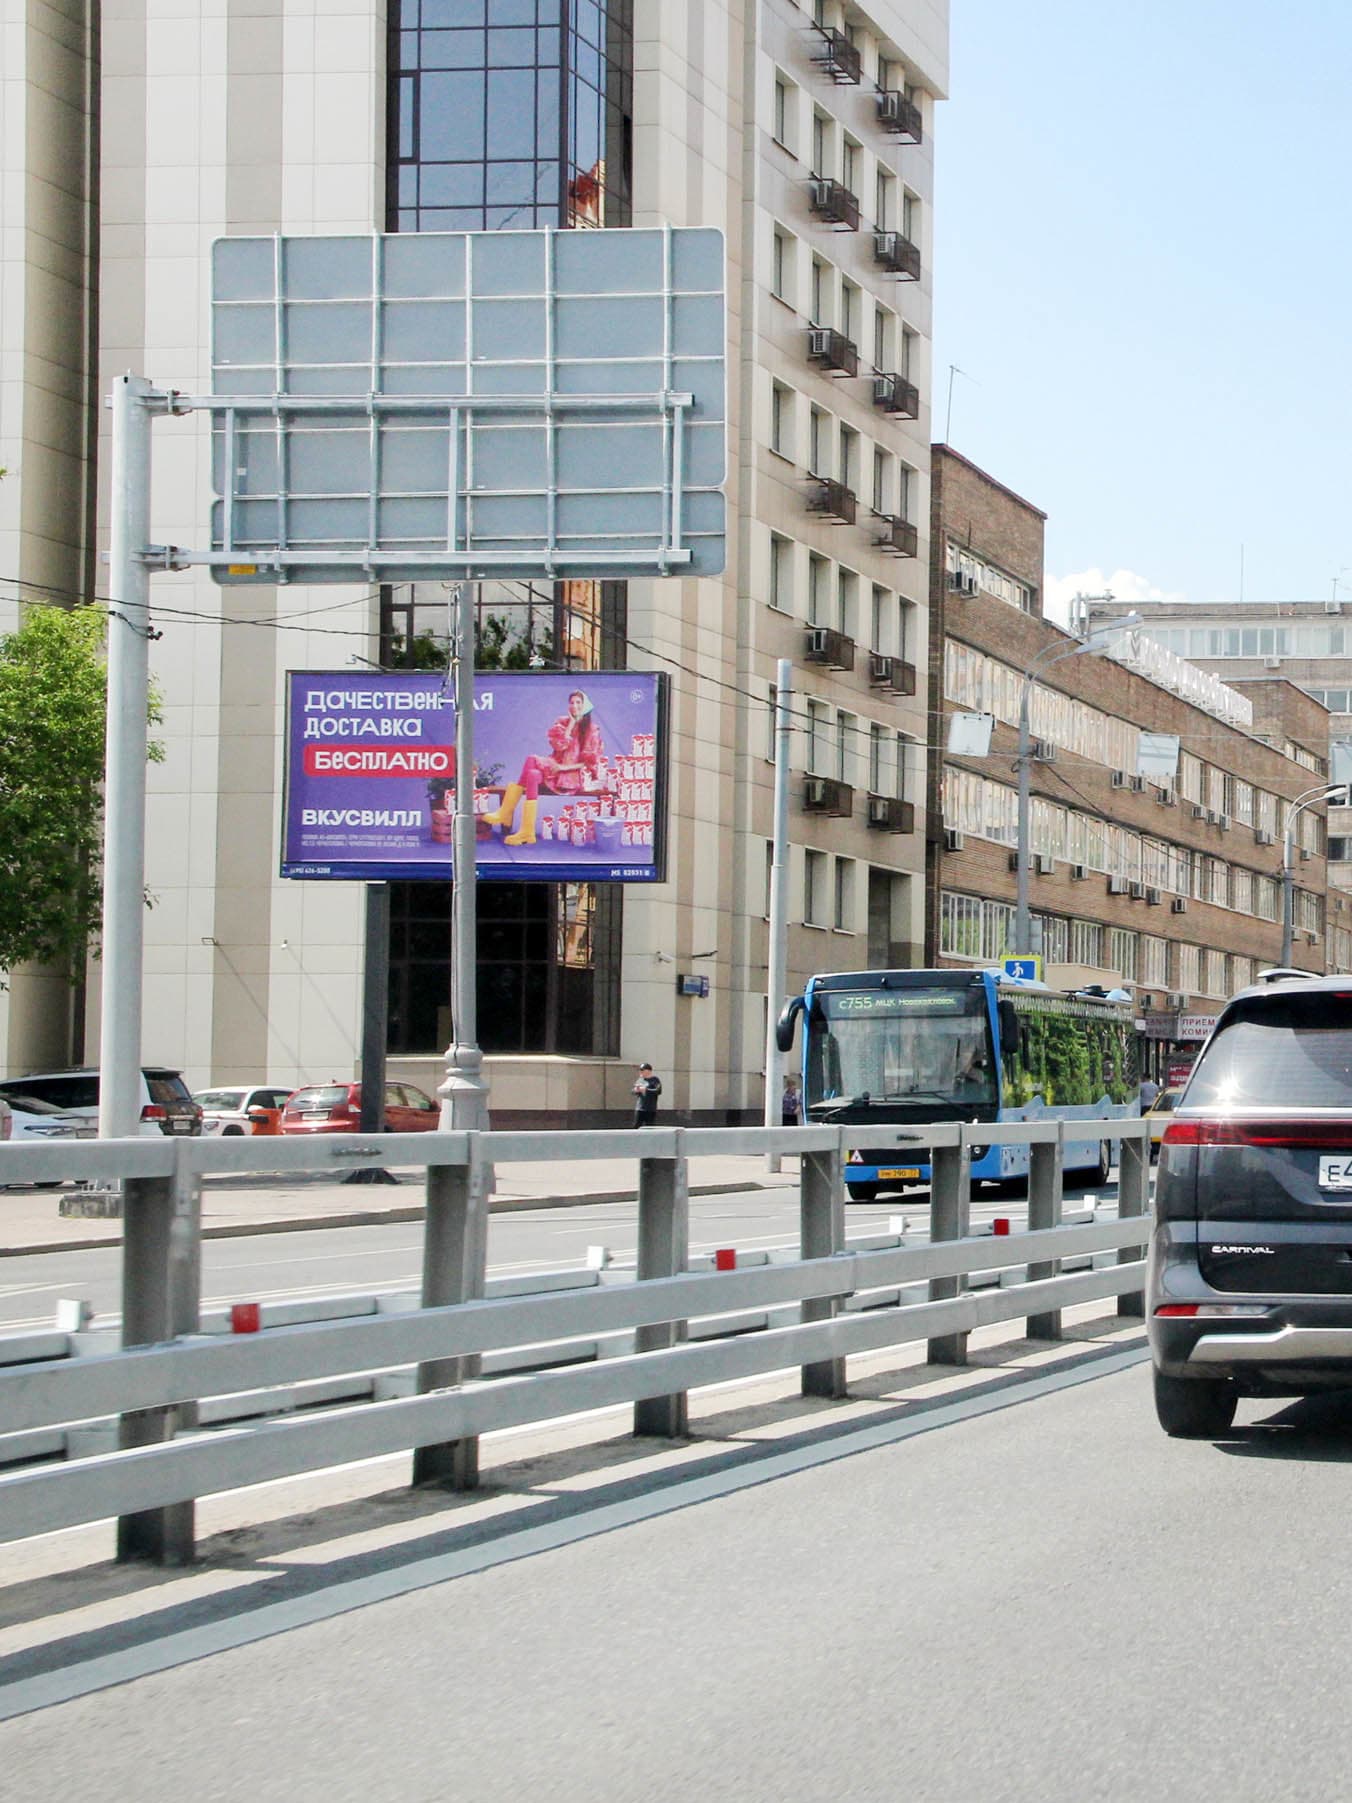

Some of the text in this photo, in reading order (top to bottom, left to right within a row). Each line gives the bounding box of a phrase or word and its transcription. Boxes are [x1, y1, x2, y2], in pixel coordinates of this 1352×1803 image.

[303, 690, 494, 713] ДАЧЕСТВЕННЯ
[303, 717, 422, 739] ДОСТАВКА
[314, 751, 448, 771] БЕСПЛАТНО
[301, 809, 422, 827] ВКУСВИЛЛ
[1182, 1018, 1216, 1026] ПРИЕМ
[1211, 1245, 1276, 1254] CARNIVAL
